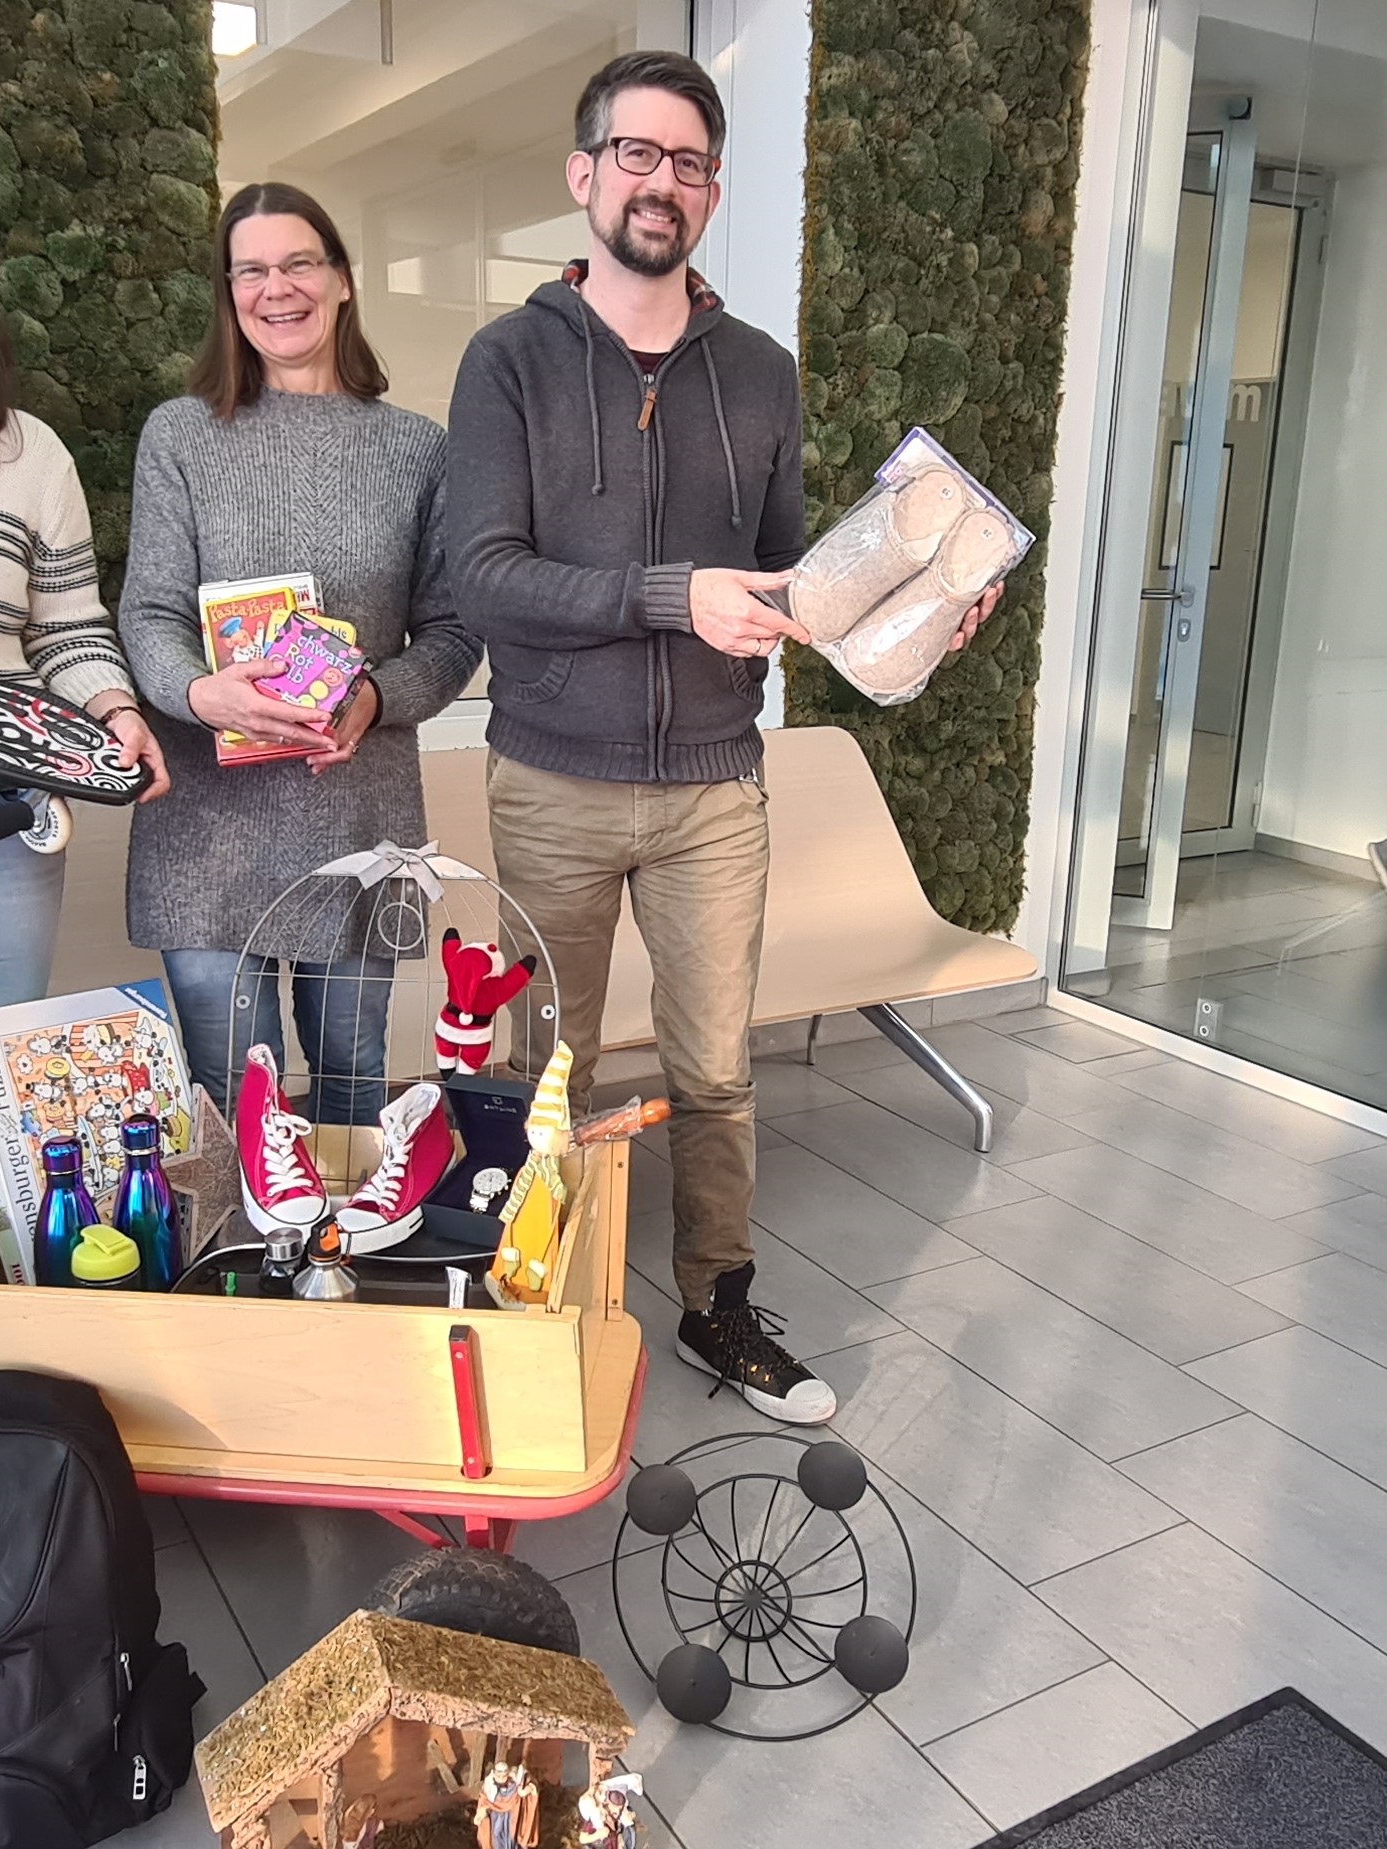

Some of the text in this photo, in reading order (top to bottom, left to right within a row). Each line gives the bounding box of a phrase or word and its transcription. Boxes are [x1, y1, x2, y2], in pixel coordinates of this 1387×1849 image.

[284, 642, 314, 669] Rot
[297, 635, 353, 673] chwarz
[4, 1135, 38, 1240] ensburger
